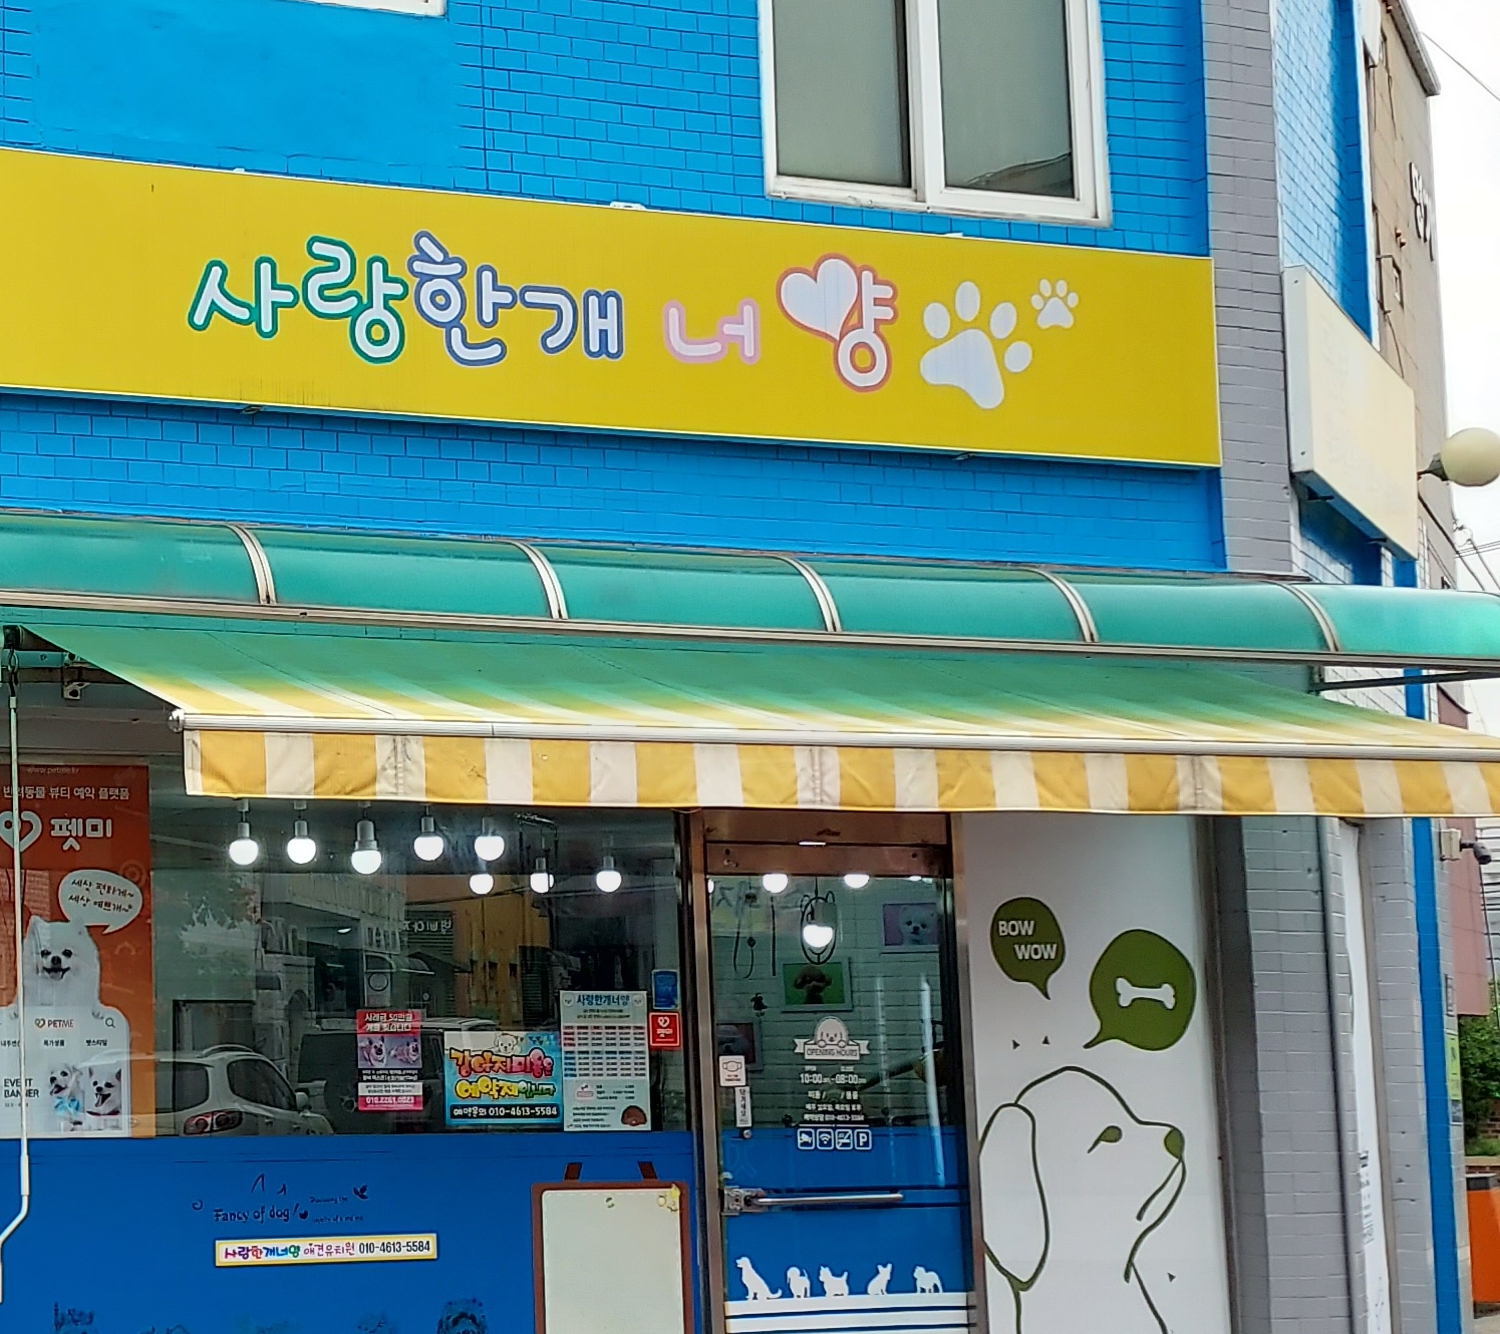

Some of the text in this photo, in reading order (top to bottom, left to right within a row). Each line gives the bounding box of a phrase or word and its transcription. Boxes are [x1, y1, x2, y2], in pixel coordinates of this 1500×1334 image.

[188, 230, 624, 367] 사랑한개
[49, 786, 70, 799] 뷰티
[73, 786, 95, 800] 예약
[98, 787, 130, 800] 플랫폼
[50, 818, 112, 852] 펫미
[998, 919, 1035, 938] BOW
[1014, 942, 1058, 961] WOW
[47, 1019, 74, 1028] PETME
[3, 1078, 33, 1087] EVET
[3, 1089, 39, 1098] BANER
[488, 1106, 558, 1116] 010-4613-5584
[212, 1207, 249, 1223] Fancy
[253, 1206, 265, 1223] of
[303, 1242, 355, 1258] 애견유치원
[358, 1240, 431, 1254] 010-4613-5584
